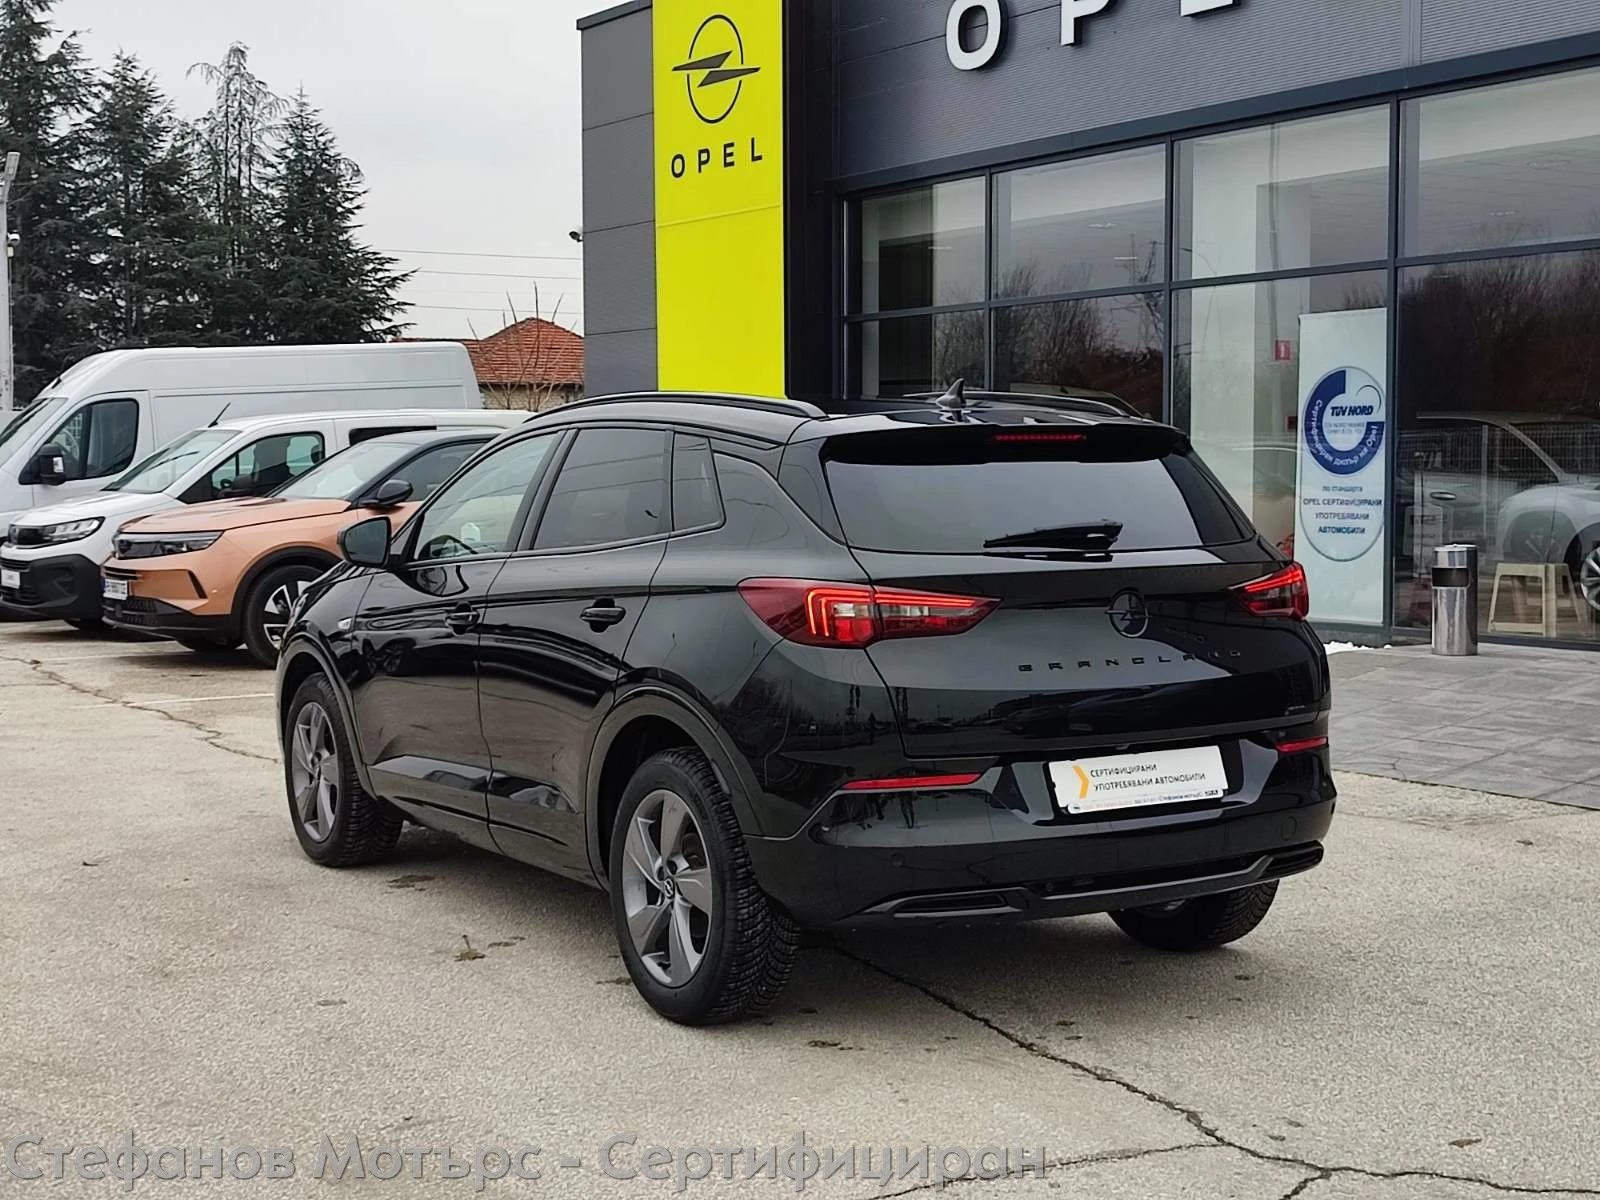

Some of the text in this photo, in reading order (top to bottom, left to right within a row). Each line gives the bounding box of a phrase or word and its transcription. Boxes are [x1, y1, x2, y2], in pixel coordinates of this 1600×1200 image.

[945, 0, 1237, 71] OP
[671, 137, 763, 179] OPEL
[1347, 405, 1374, 416] NORD
[1366, 425, 1379, 447] Opel
[1322, 498, 1382, 506] СЕРТИФИЦИРАНИ
[1315, 512, 1369, 520] УПОТРЕБЯВАНИ
[1318, 526, 1365, 534] АВТОМОБИЛИ
[1090, 763, 1157, 778] СЕРТИФИЦИРАНИ
[1094, 772, 1206, 792] УПОТРЕБЯВАНИ АВТОМОБИЛИ
